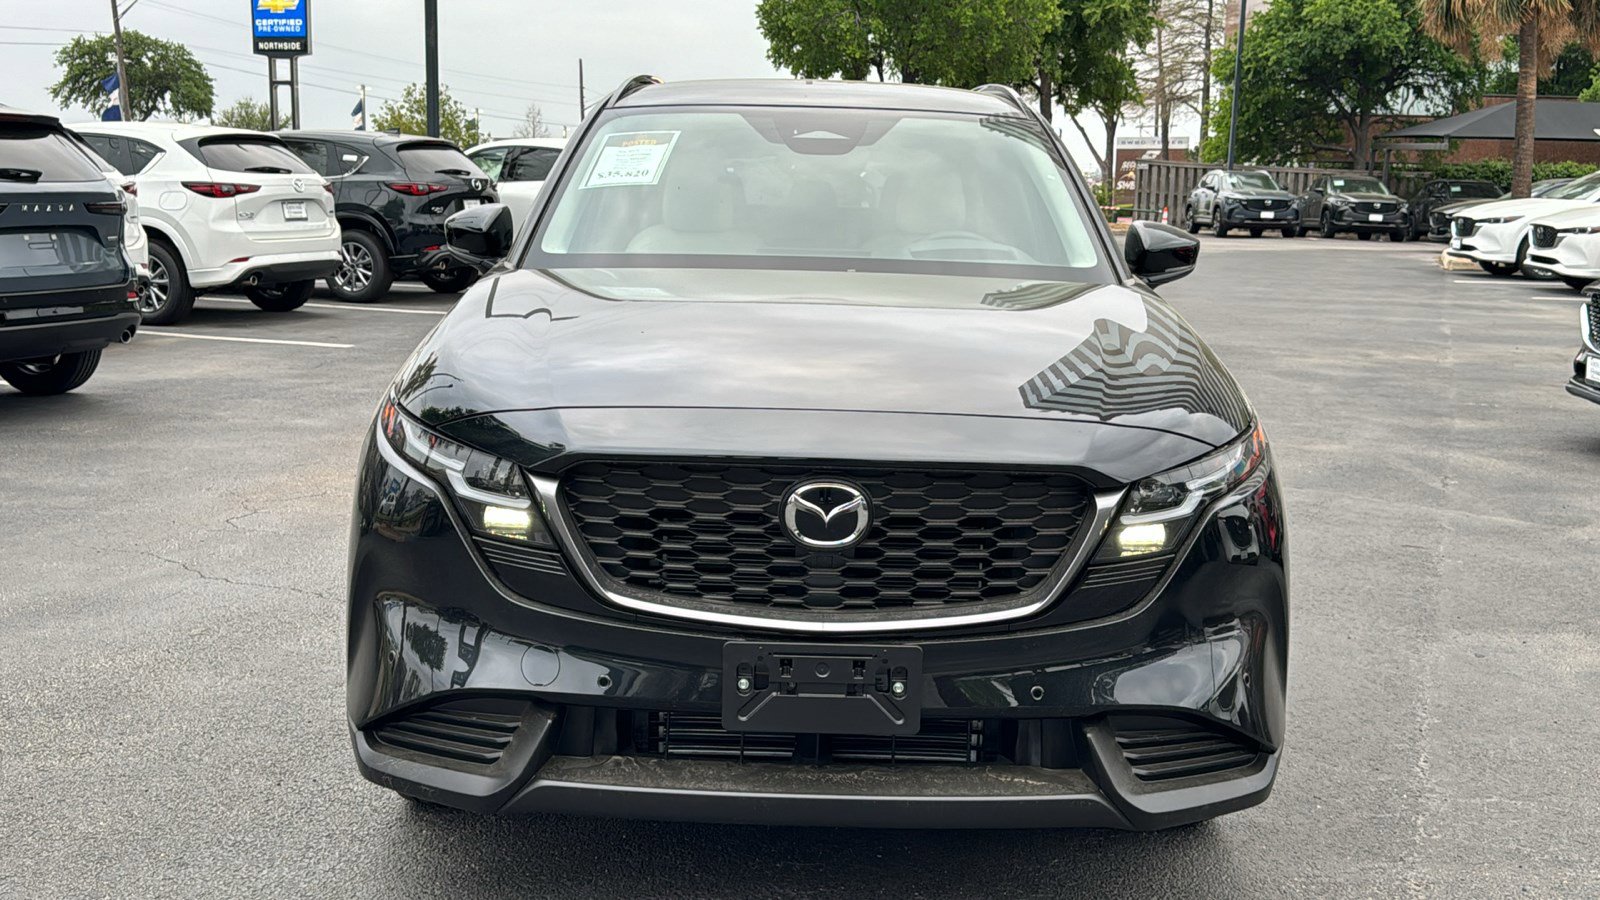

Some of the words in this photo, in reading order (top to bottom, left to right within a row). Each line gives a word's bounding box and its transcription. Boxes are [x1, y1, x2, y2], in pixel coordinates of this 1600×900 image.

[255, 18, 303, 26] CERTIFIED
[258, 25, 301, 33] PRE-OWNED
[258, 42, 301, 50] NORTHSIDE
[21, 204, 74, 212] MAZDA
